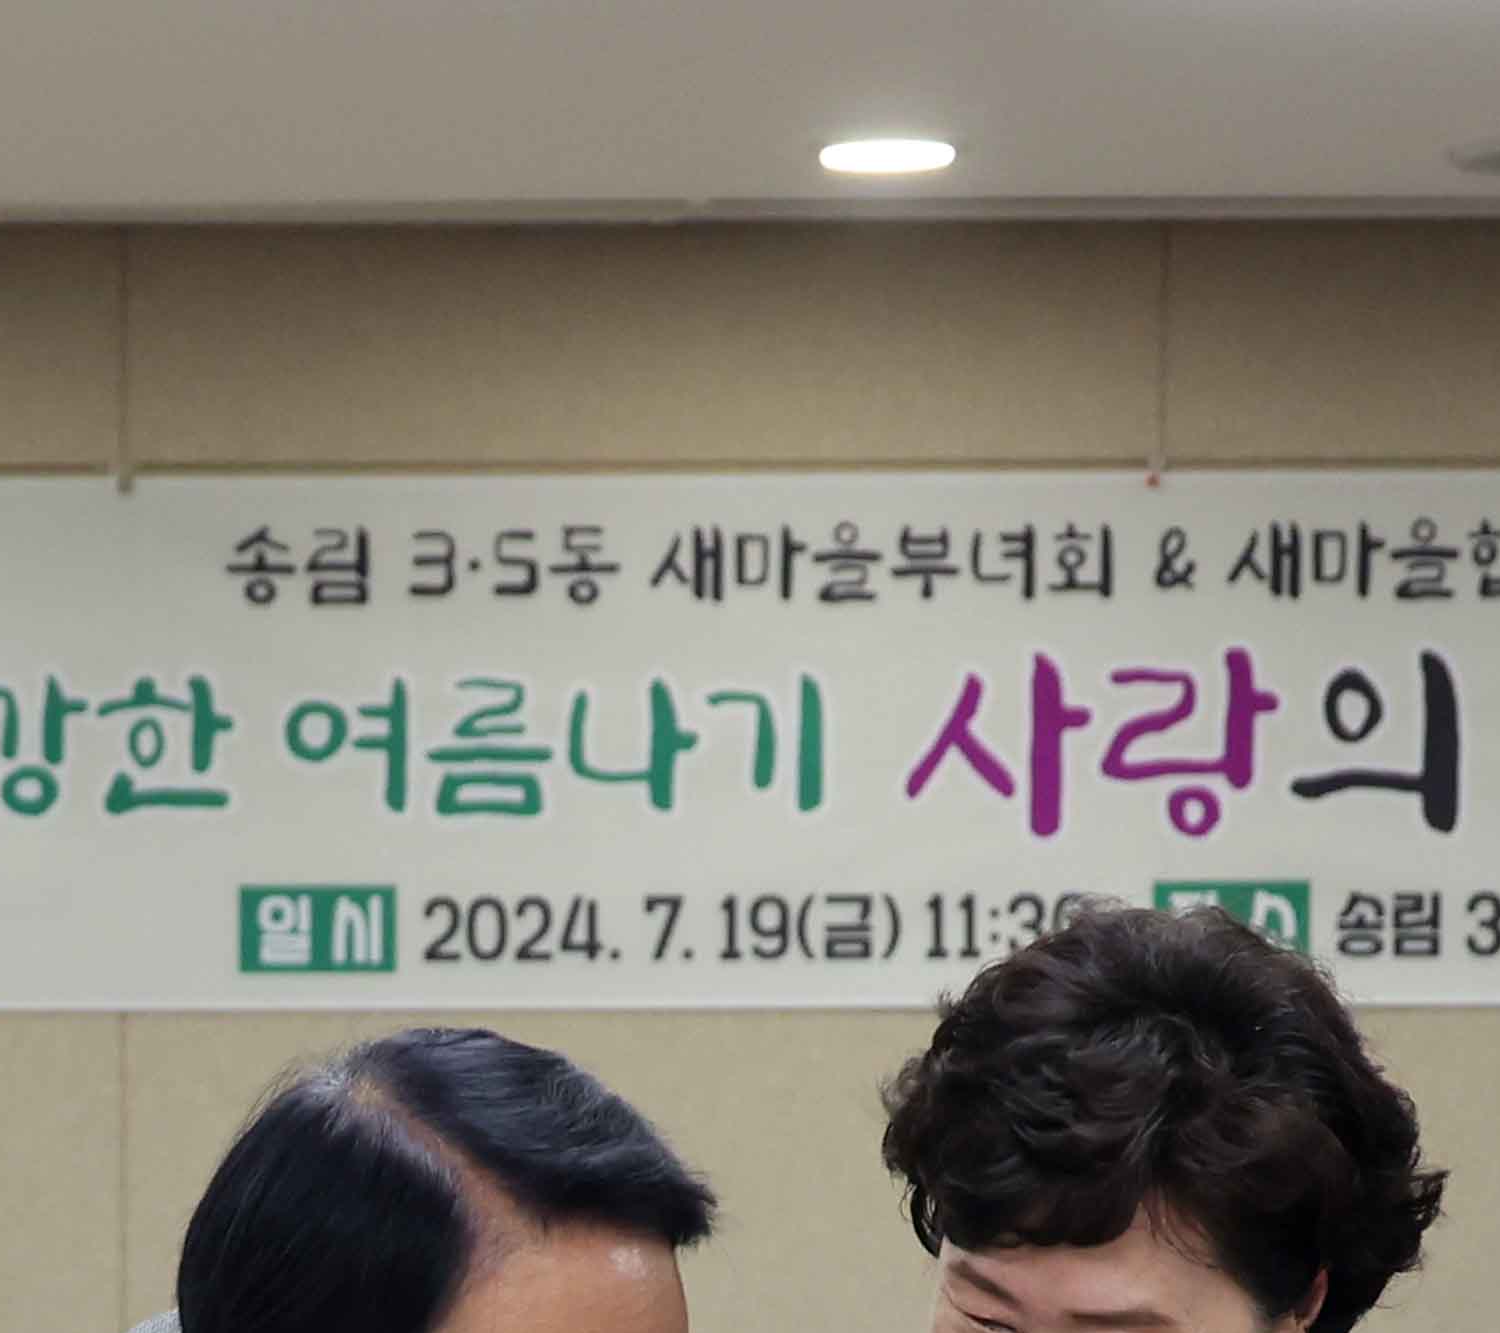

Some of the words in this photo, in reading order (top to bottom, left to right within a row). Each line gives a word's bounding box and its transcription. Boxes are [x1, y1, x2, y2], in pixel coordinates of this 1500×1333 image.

[226, 526, 371, 606] 송림
[650, 524, 1114, 603] 새마을부녀회
[1154, 527, 1196, 590] &
[283, 674, 825, 818] 여름나기
[905, 646, 1461, 838] 사랑의
[1338, 892, 1441, 957] 송림
